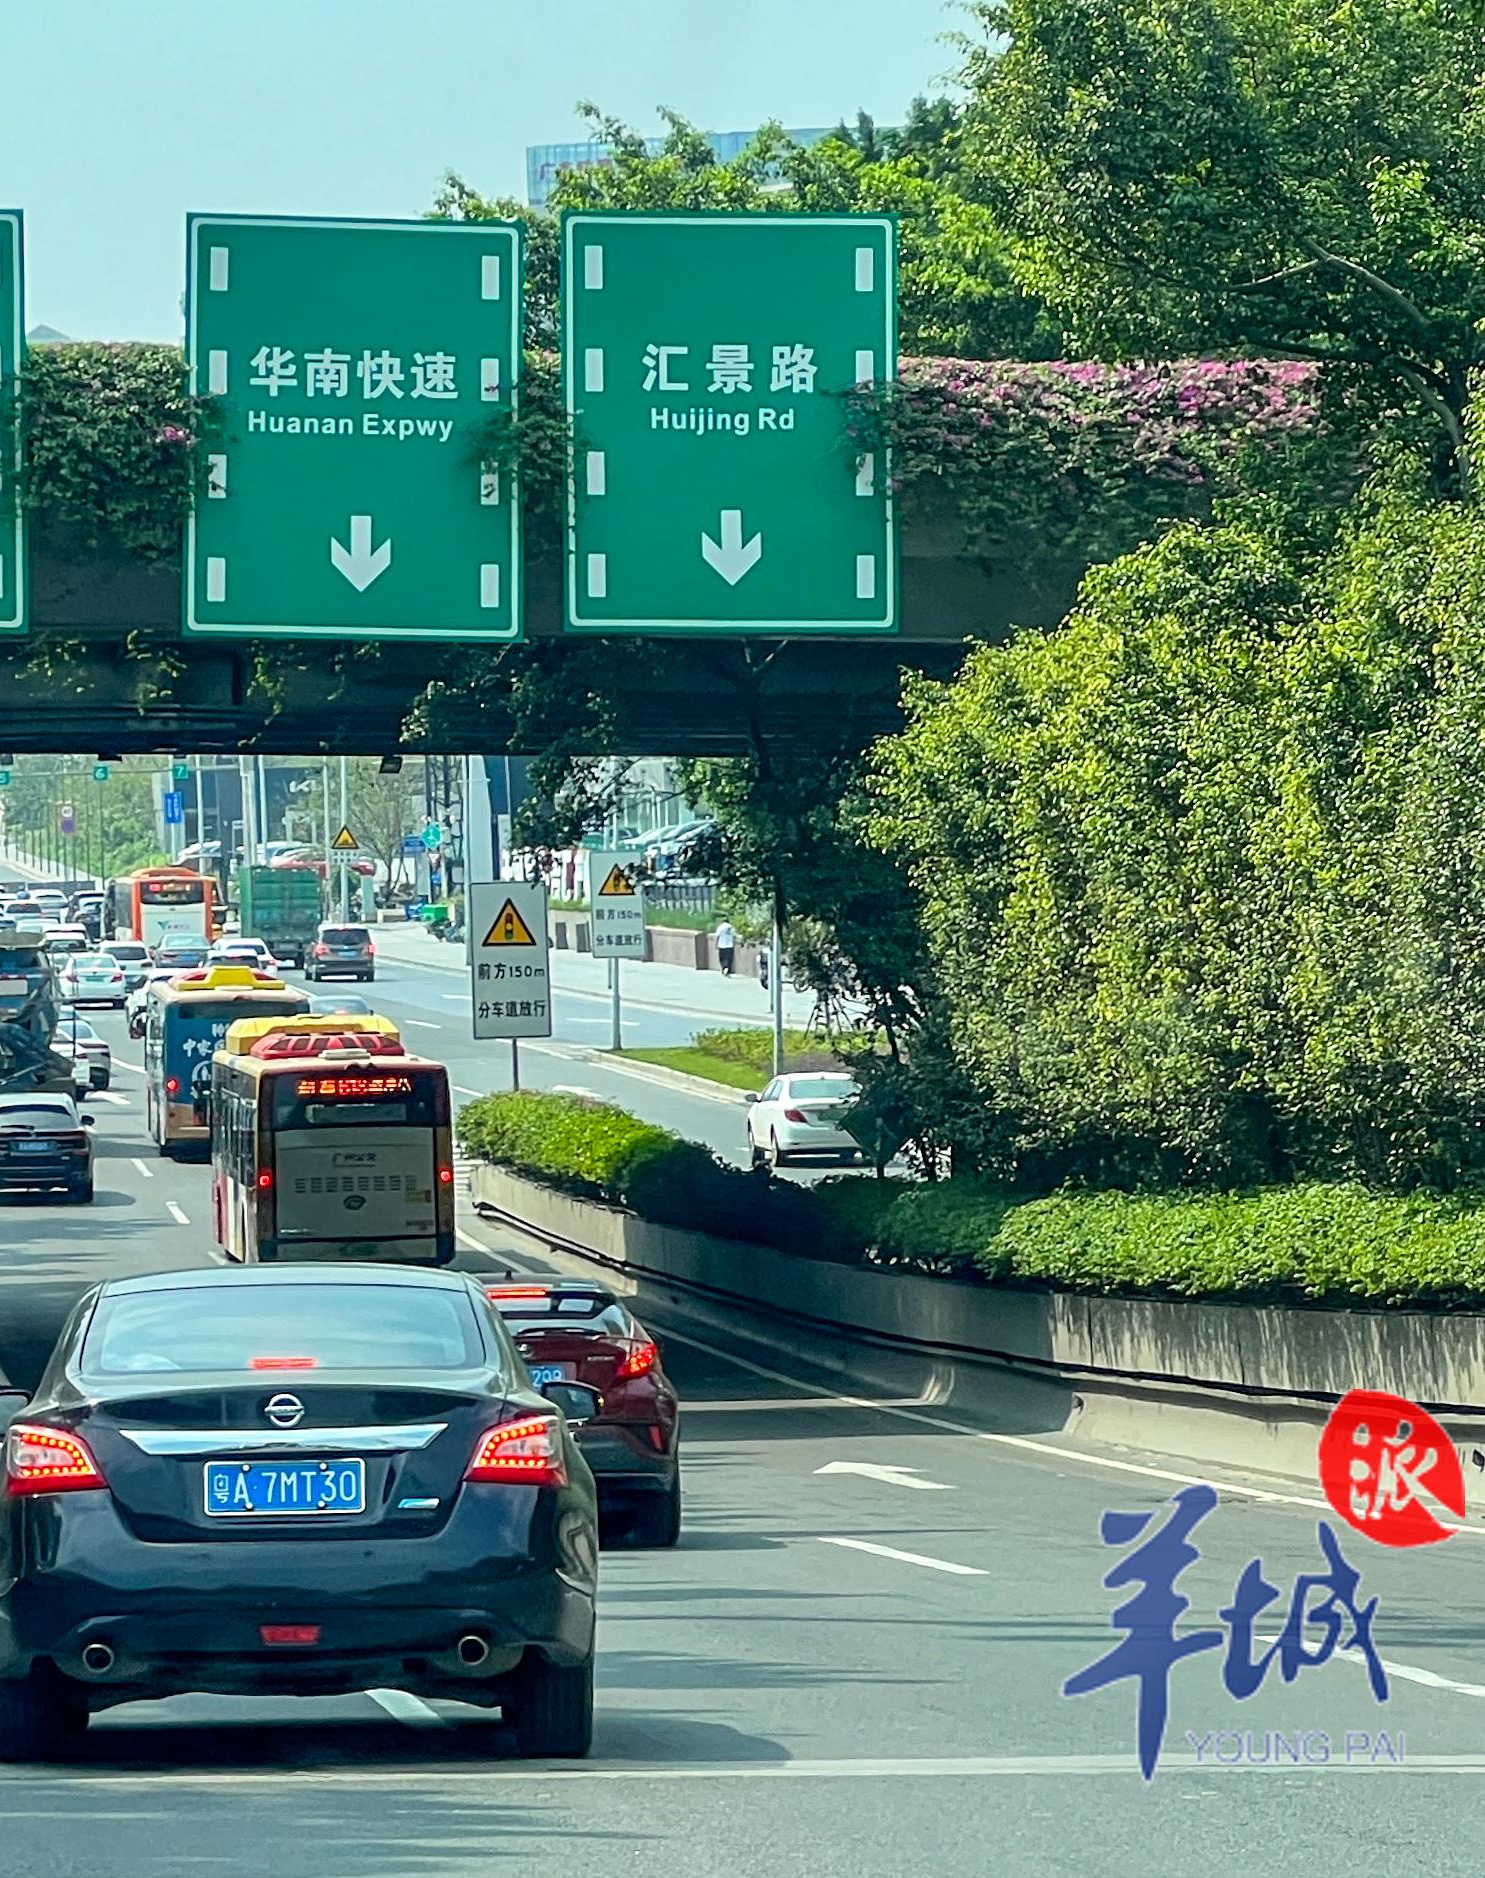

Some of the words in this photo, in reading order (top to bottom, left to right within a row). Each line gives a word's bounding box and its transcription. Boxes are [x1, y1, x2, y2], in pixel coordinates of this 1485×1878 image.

[249, 345, 459, 401] 华南快速
[642, 343, 818, 395] 汇景路
[247, 409, 355, 436] Huanan
[362, 412, 454, 443] Expwy
[650, 406, 751, 437] Huijing
[758, 407, 795, 431] Rd
[478, 963, 545, 980] 前方150m
[478, 1000, 546, 1019] 分车道放行
